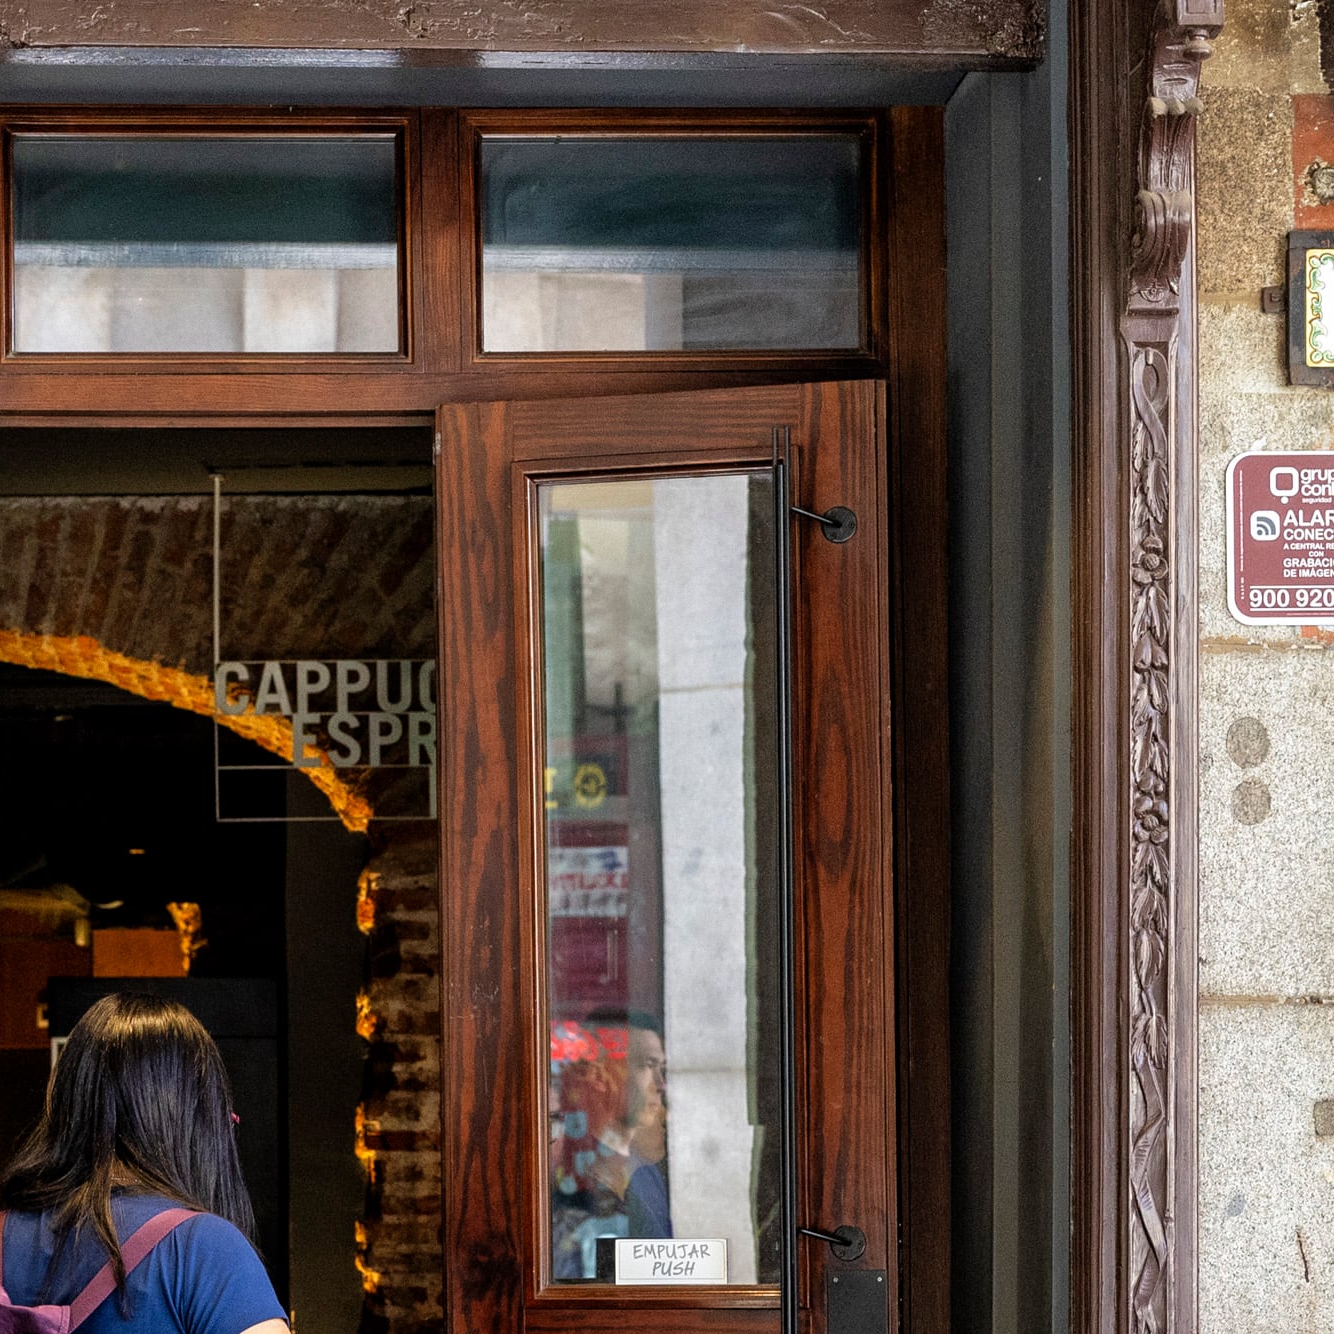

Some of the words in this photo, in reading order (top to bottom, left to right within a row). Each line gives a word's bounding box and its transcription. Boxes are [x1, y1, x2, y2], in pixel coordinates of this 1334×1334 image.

[1283, 569, 1297, 578] DE
[1249, 588, 1290, 608] 900
[633, 1243, 711, 1260] EMPUJAR
[652, 1260, 696, 1277] PUSH
